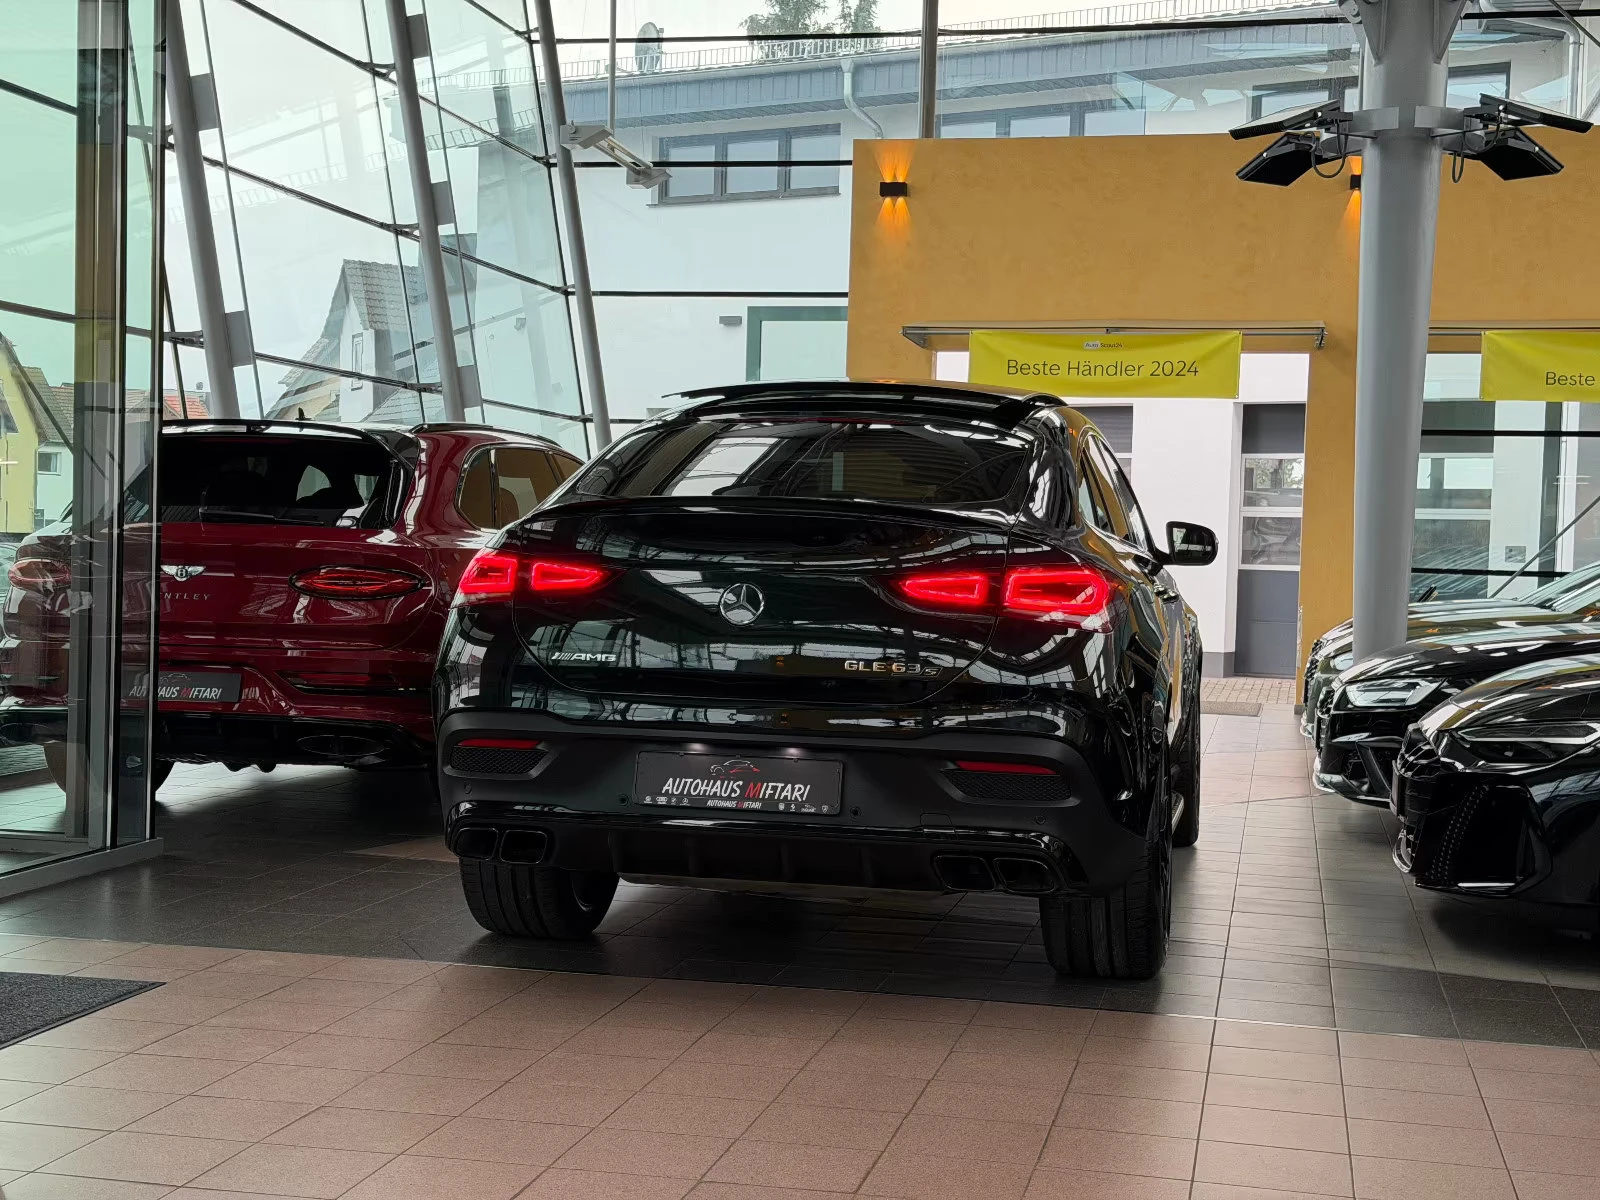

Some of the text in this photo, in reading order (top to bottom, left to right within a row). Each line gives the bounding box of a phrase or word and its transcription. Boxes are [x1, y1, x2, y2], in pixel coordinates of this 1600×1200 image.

[1007, 359, 1200, 377] Beste Händler 2024
[1545, 371, 1596, 386] Beste
[160, 592, 210, 600] NTLEY
[844, 660, 887, 672] GLE
[892, 662, 921, 673] 63
[128, 685, 223, 700] AUTAUS MIFTARI
[661, 777, 811, 802] AUTOHAUS MIFTARI
[706, 799, 762, 809] AUTOHAUS MIFTARI
